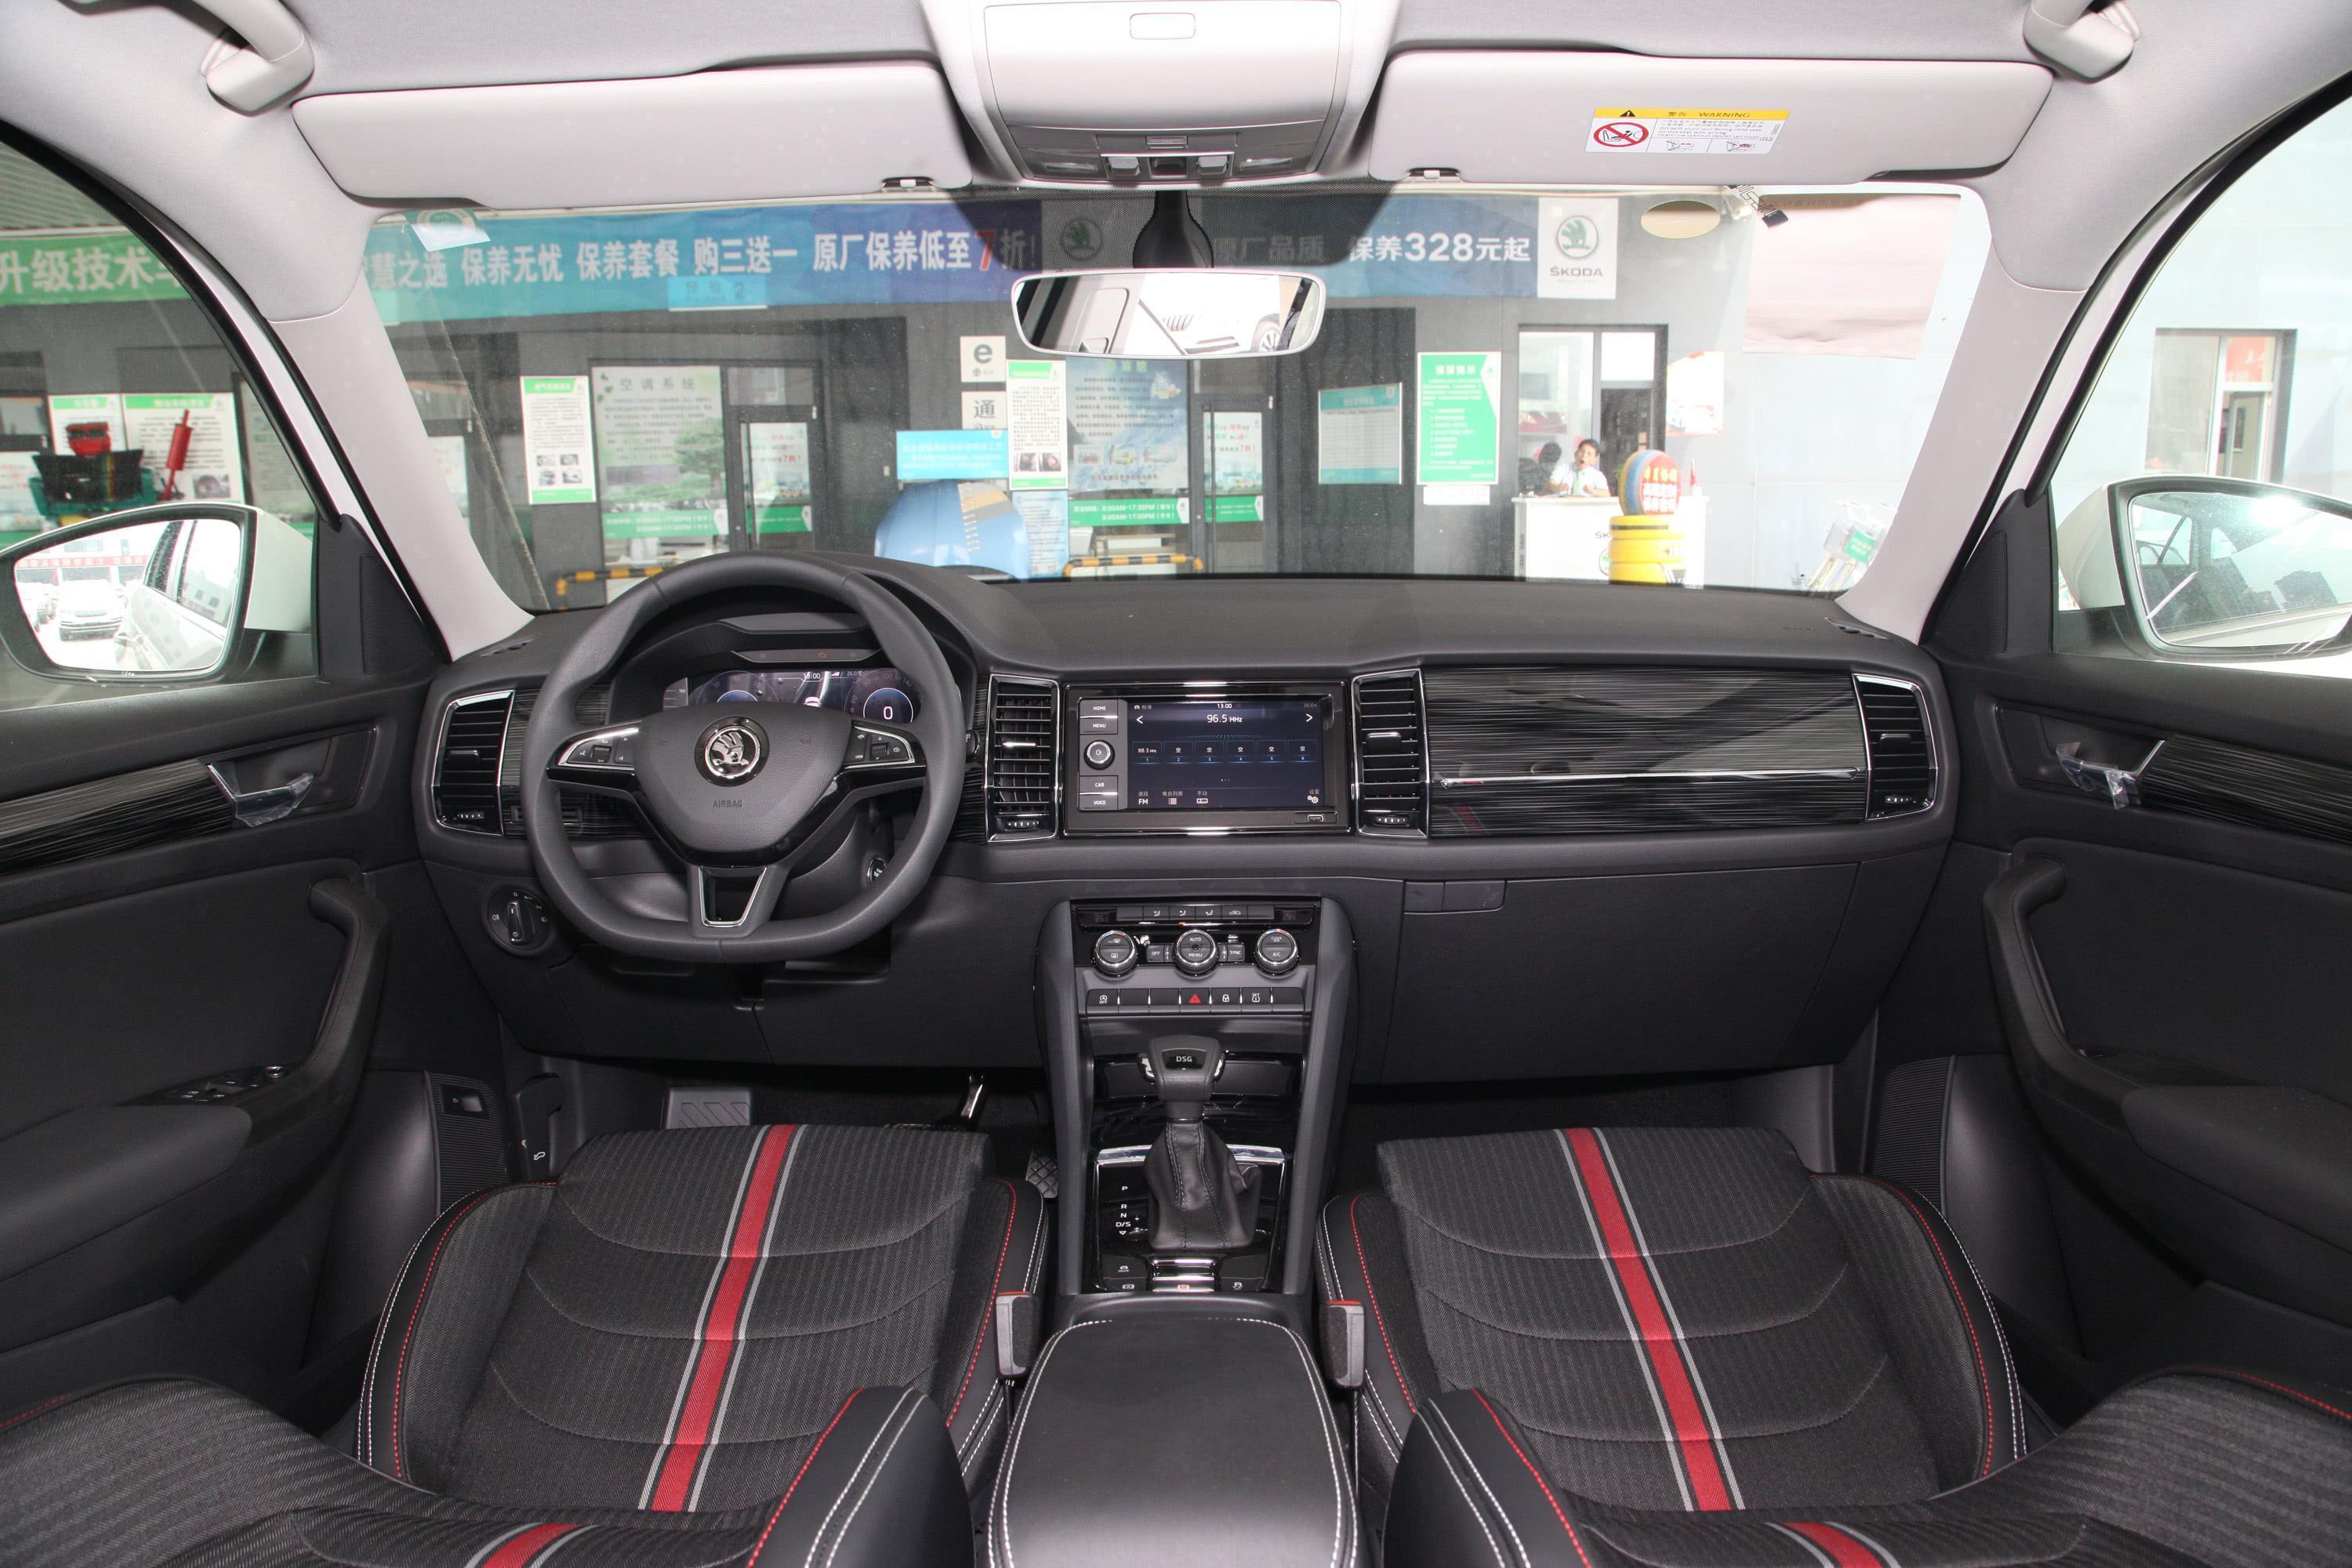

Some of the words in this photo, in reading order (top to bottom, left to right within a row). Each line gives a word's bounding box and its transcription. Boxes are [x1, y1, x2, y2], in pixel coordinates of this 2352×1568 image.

[1348, 231, 1531, 262] 保养328元起
[460, 242, 564, 288] 保养无忧
[577, 238, 680, 281] 保养套餐
[693, 236, 798, 275] 购三送一
[1549, 265, 1603, 277] ŠKODA
[973, 343, 993, 364] e
[619, 376, 695, 390] 空调系统
[973, 399, 996, 419] 通
[883, 706, 893, 720] 0
[1207, 714, 1228, 723] 96.5
[713, 800, 743, 808] AIRBAG
